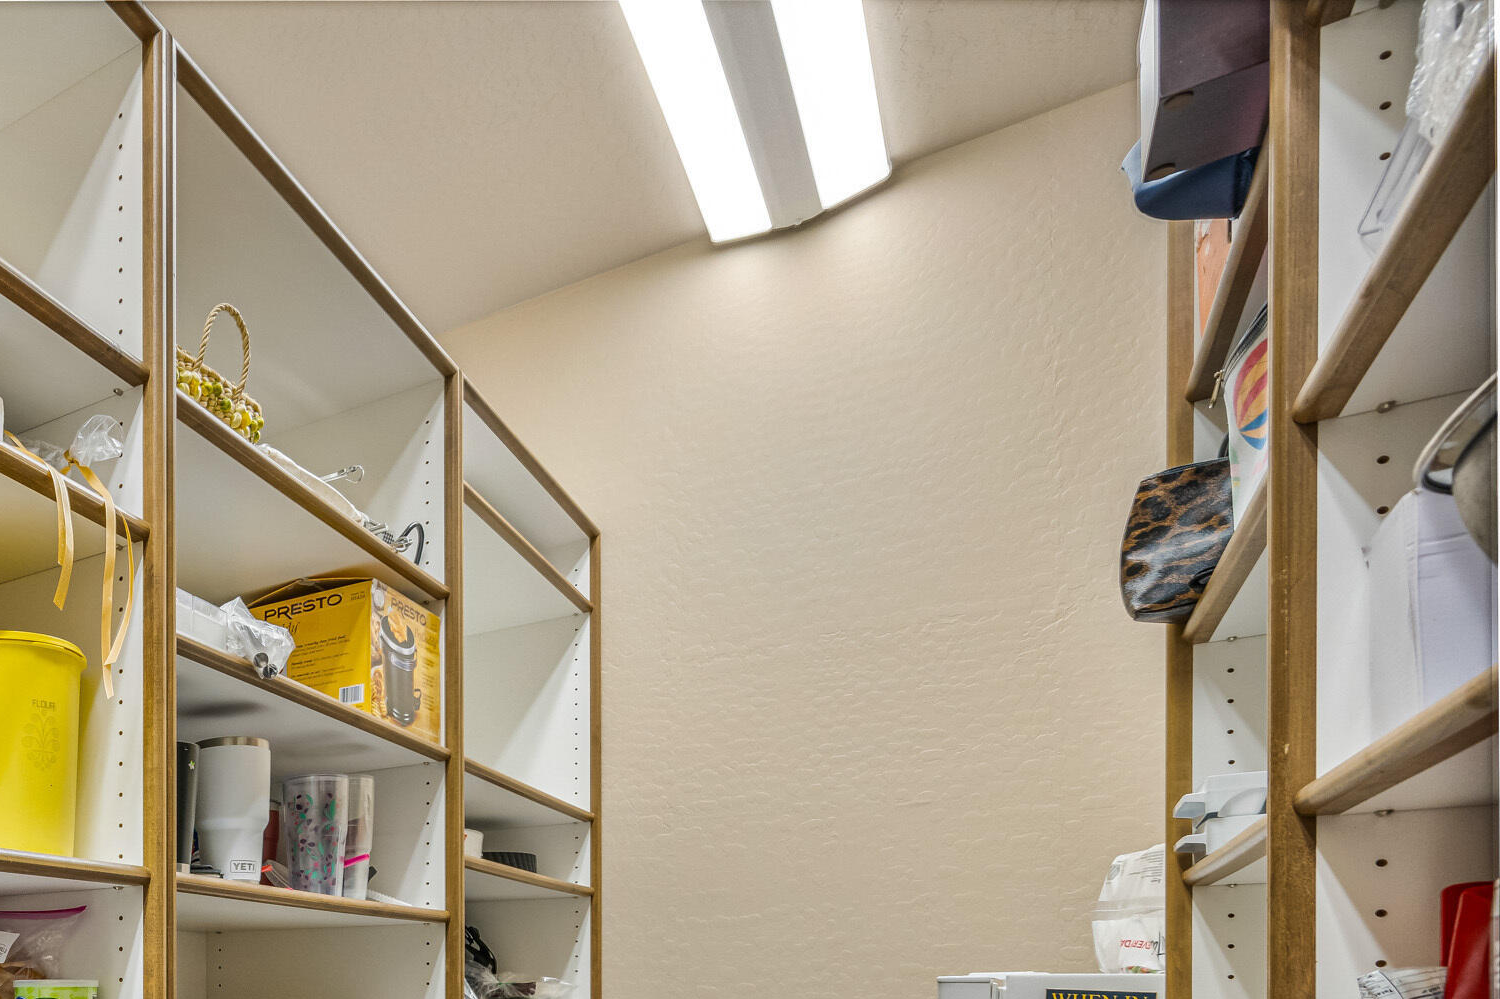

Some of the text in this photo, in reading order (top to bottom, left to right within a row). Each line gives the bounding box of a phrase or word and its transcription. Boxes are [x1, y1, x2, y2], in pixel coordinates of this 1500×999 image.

[264, 593, 343, 621] PRESTO
[391, 598, 427, 627] PRESTO
[232, 861, 255, 873] YETI
